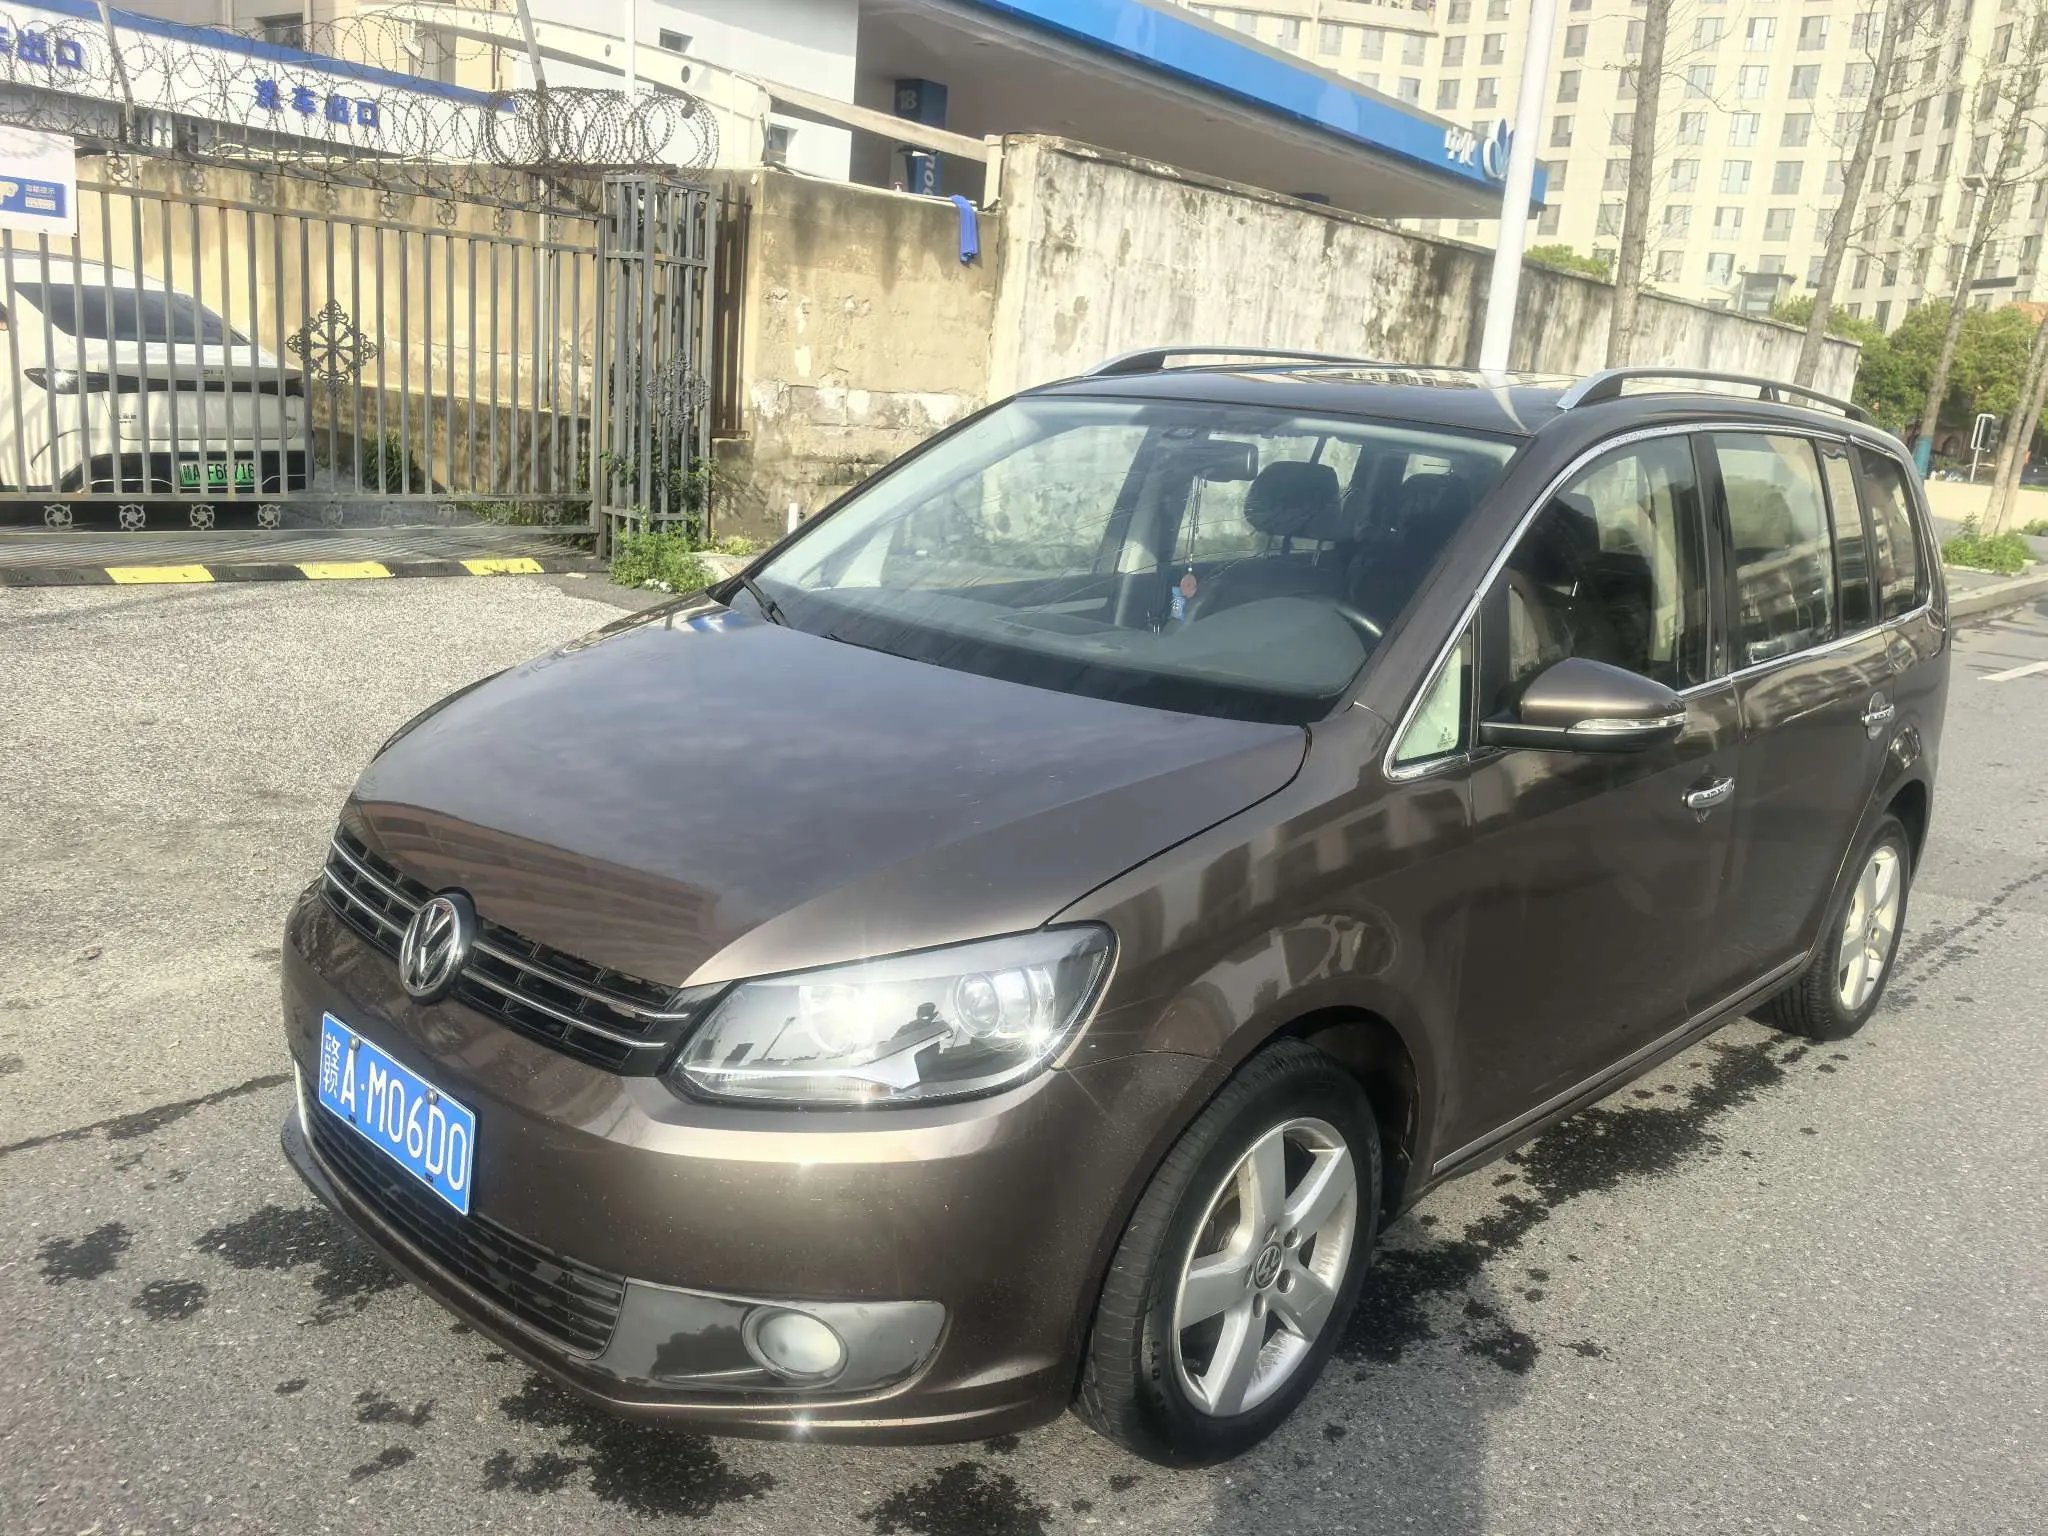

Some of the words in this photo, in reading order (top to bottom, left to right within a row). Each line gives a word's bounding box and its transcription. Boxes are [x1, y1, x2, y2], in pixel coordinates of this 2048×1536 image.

[254, 79, 379, 128] 洗车出口
[1444, 126, 1476, 167] 中化
